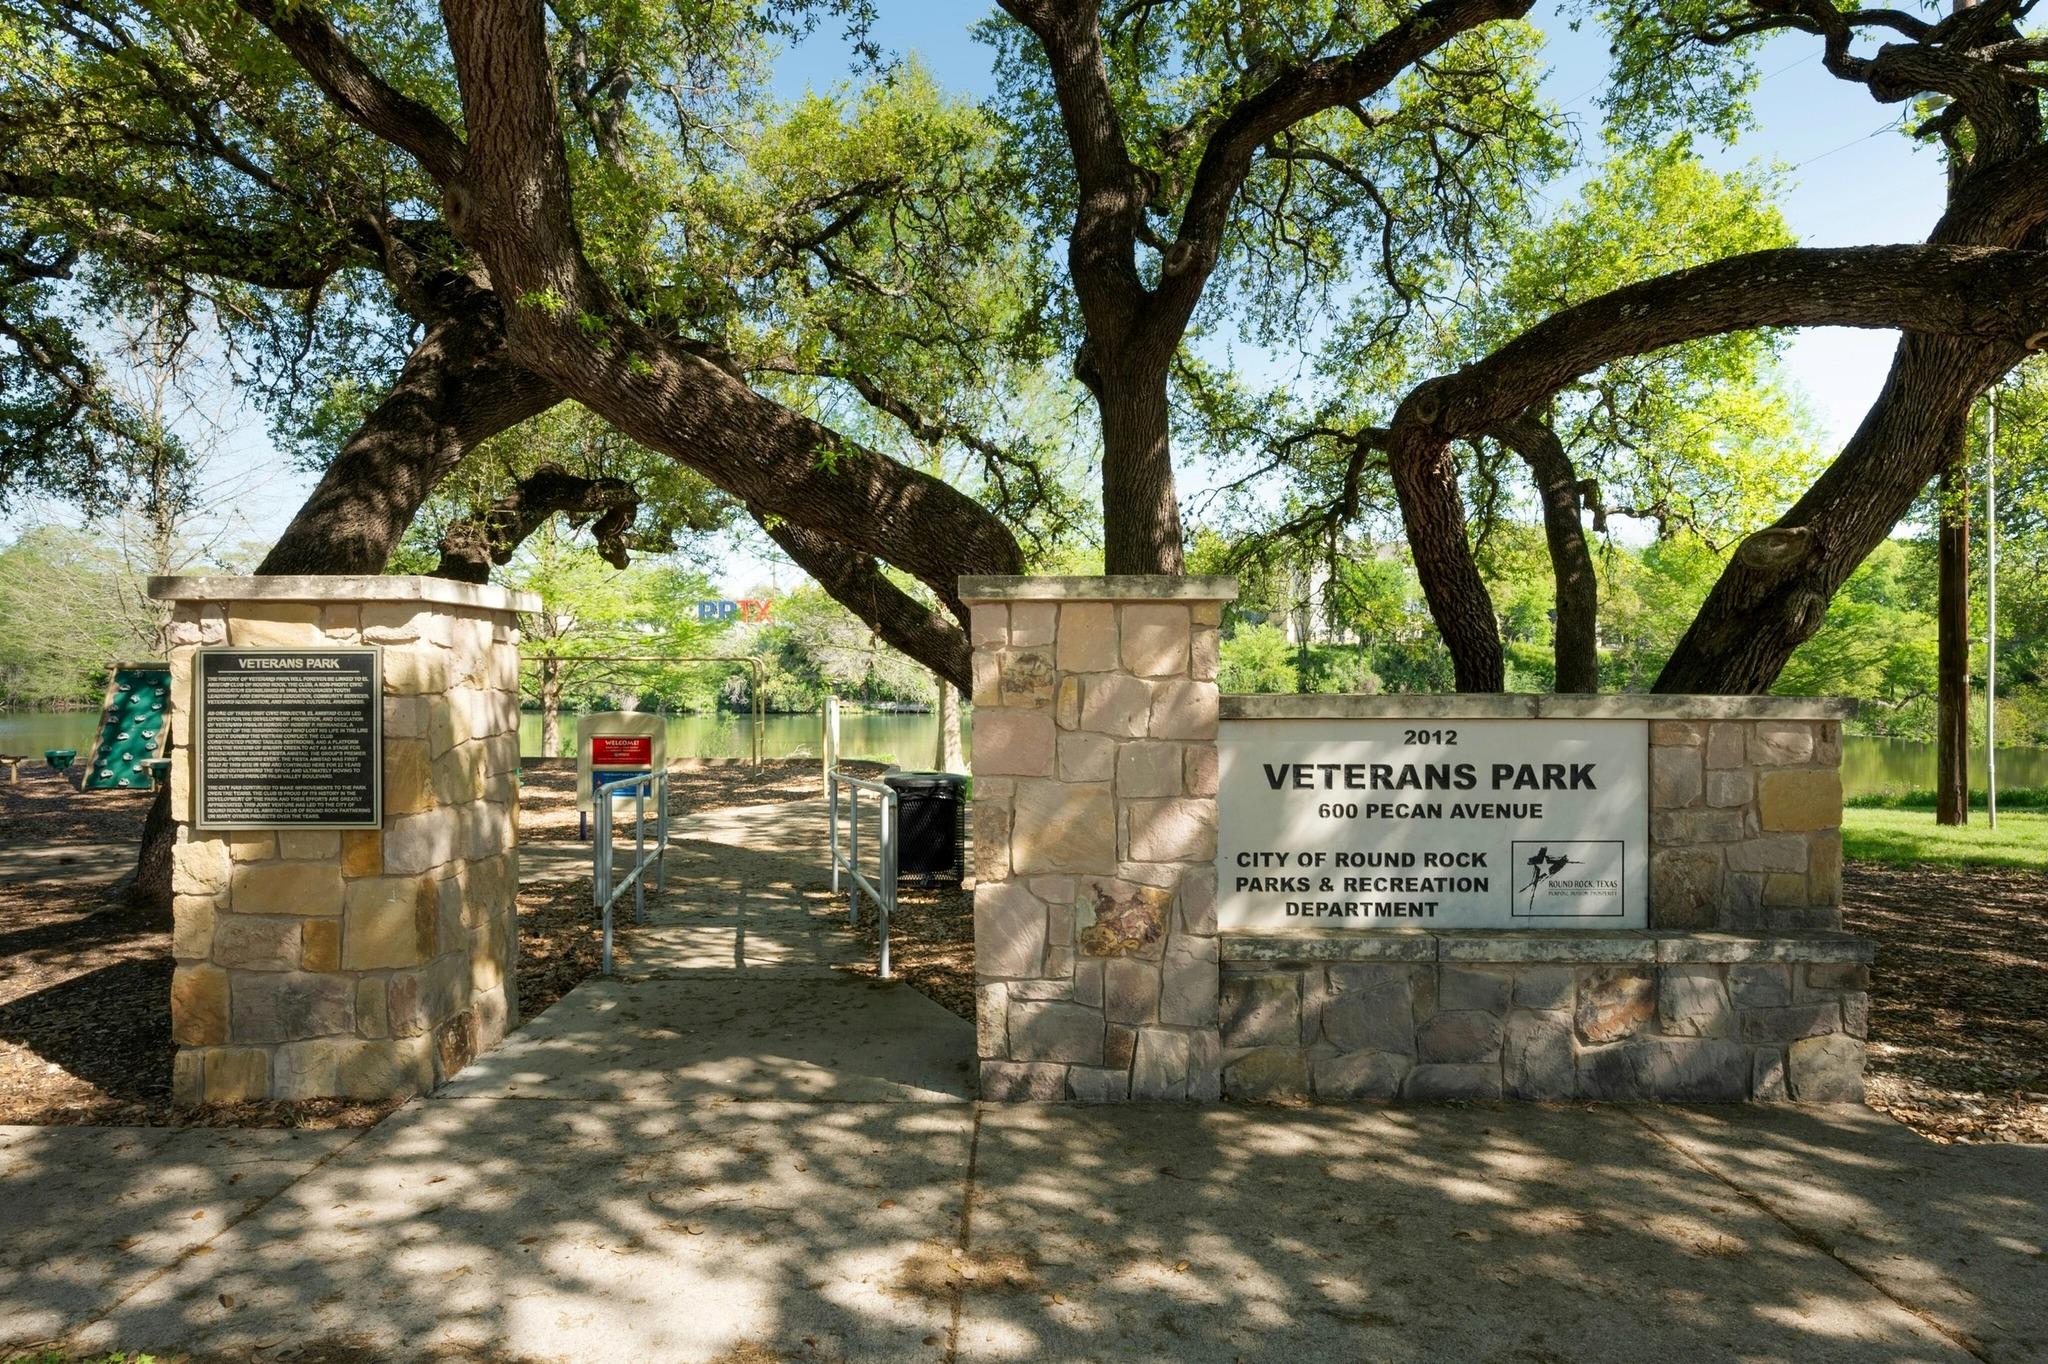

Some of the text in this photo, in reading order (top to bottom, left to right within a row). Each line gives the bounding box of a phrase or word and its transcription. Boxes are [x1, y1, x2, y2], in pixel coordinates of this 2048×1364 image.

[238, 658, 340, 669] VETERANS PARK
[1405, 730, 1457, 745] 2012
[1263, 764, 1596, 790] VETERANS PARK
[1320, 804, 1542, 818] 600 PECAN AVENUE
[1237, 852, 1487, 867] CITY OF ROUND ROCK
[1236, 877, 1488, 892] PARKS & RECREATION
[1548, 880, 1574, 888] ROUND
[1596, 880, 1618, 888] TEXAS
[1286, 902, 1438, 917] DEPARTMENT
